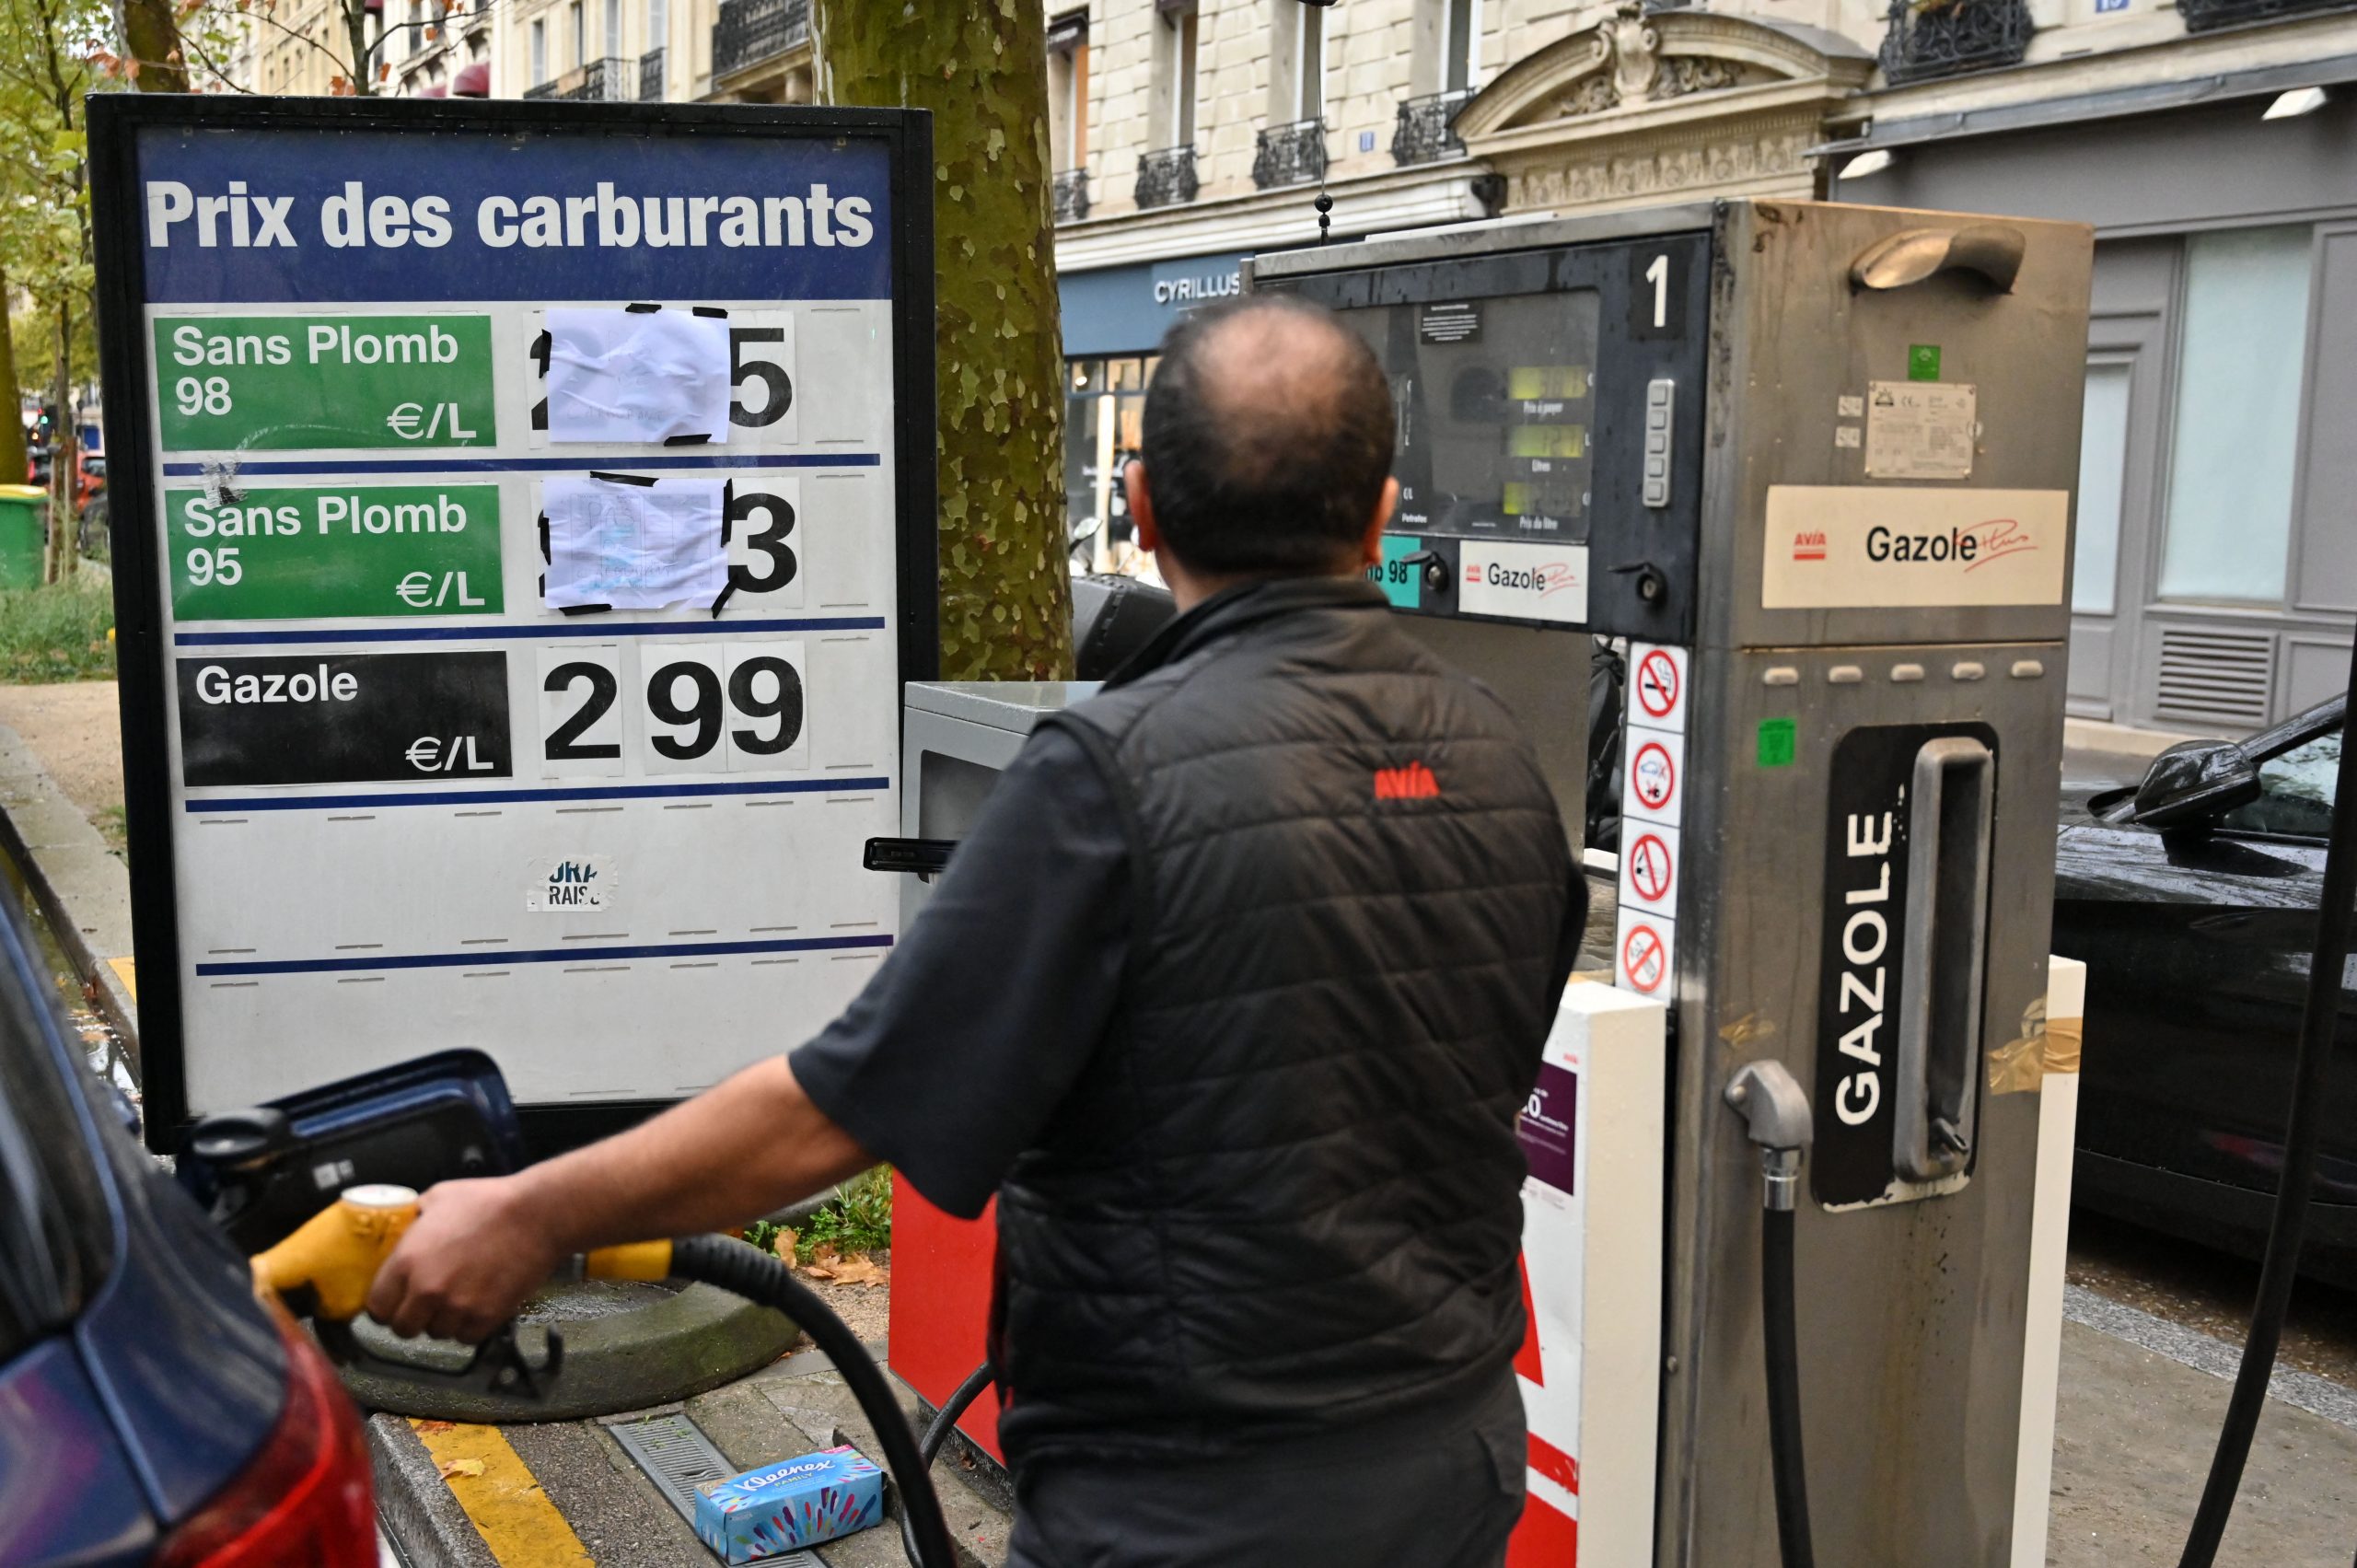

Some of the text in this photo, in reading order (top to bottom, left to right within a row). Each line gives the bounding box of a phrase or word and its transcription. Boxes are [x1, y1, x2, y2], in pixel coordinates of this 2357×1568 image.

[146, 181, 874, 248] Prix des carburants
[1154, 272, 1240, 304] CYRILLUS
[1645, 254, 1668, 328] 1
[173, 325, 459, 366] Sans Plomb
[175, 376, 233, 416] 98
[386, 402, 477, 440] €/L
[184, 494, 467, 538] Sans Plomb
[1794, 531, 1827, 547] AVIA
[1866, 526, 1977, 562] Gazole
[186, 547, 243, 586] 95
[1388, 560, 1408, 585] 98
[1488, 563, 1546, 591] Gazole
[395, 571, 485, 608] €/L
[195, 663, 358, 704] Gazole
[404, 737, 494, 772] €/L
[1375, 761, 1440, 799] AVIA
[1835, 811, 1893, 1125] GAZOLE
[733, 1460, 836, 1492] Kleenex
[774, 1472, 814, 1487] FAMILY
